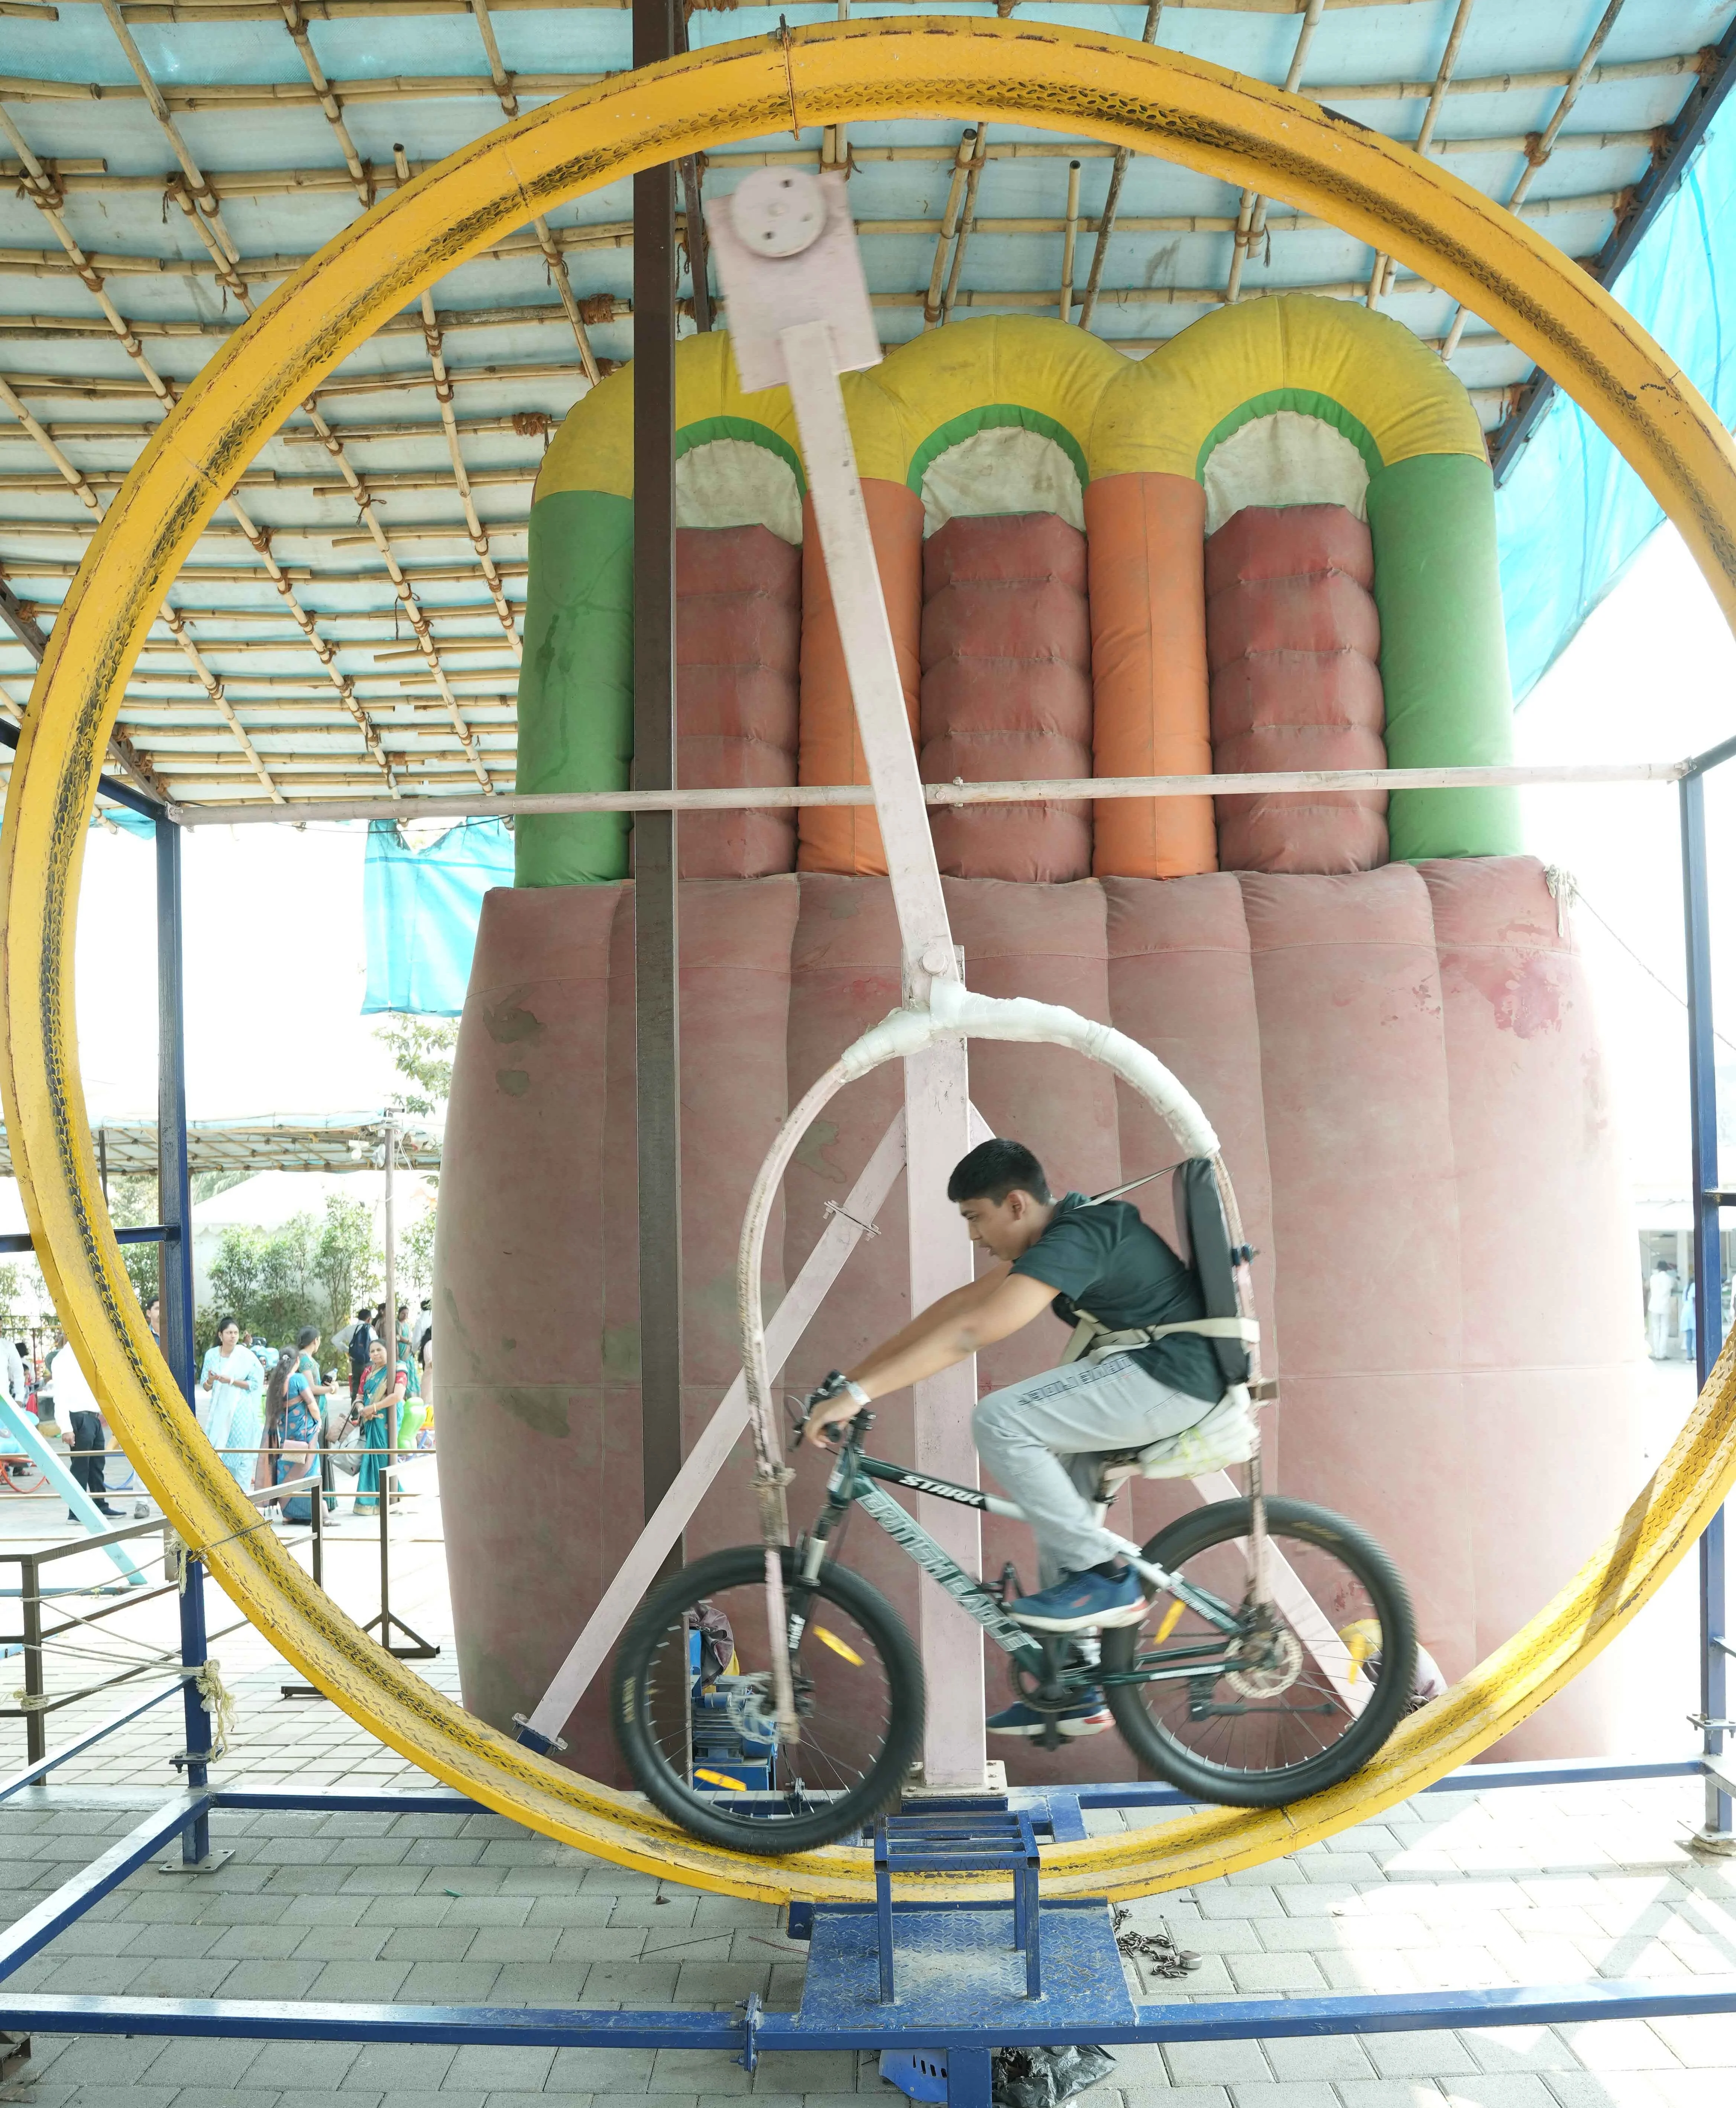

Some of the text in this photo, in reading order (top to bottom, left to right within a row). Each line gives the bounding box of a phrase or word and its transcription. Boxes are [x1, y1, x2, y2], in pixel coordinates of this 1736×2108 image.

[899, 1475, 985, 1505] STARK
[855, 1491, 1043, 1652] BRITISH EAGLE
